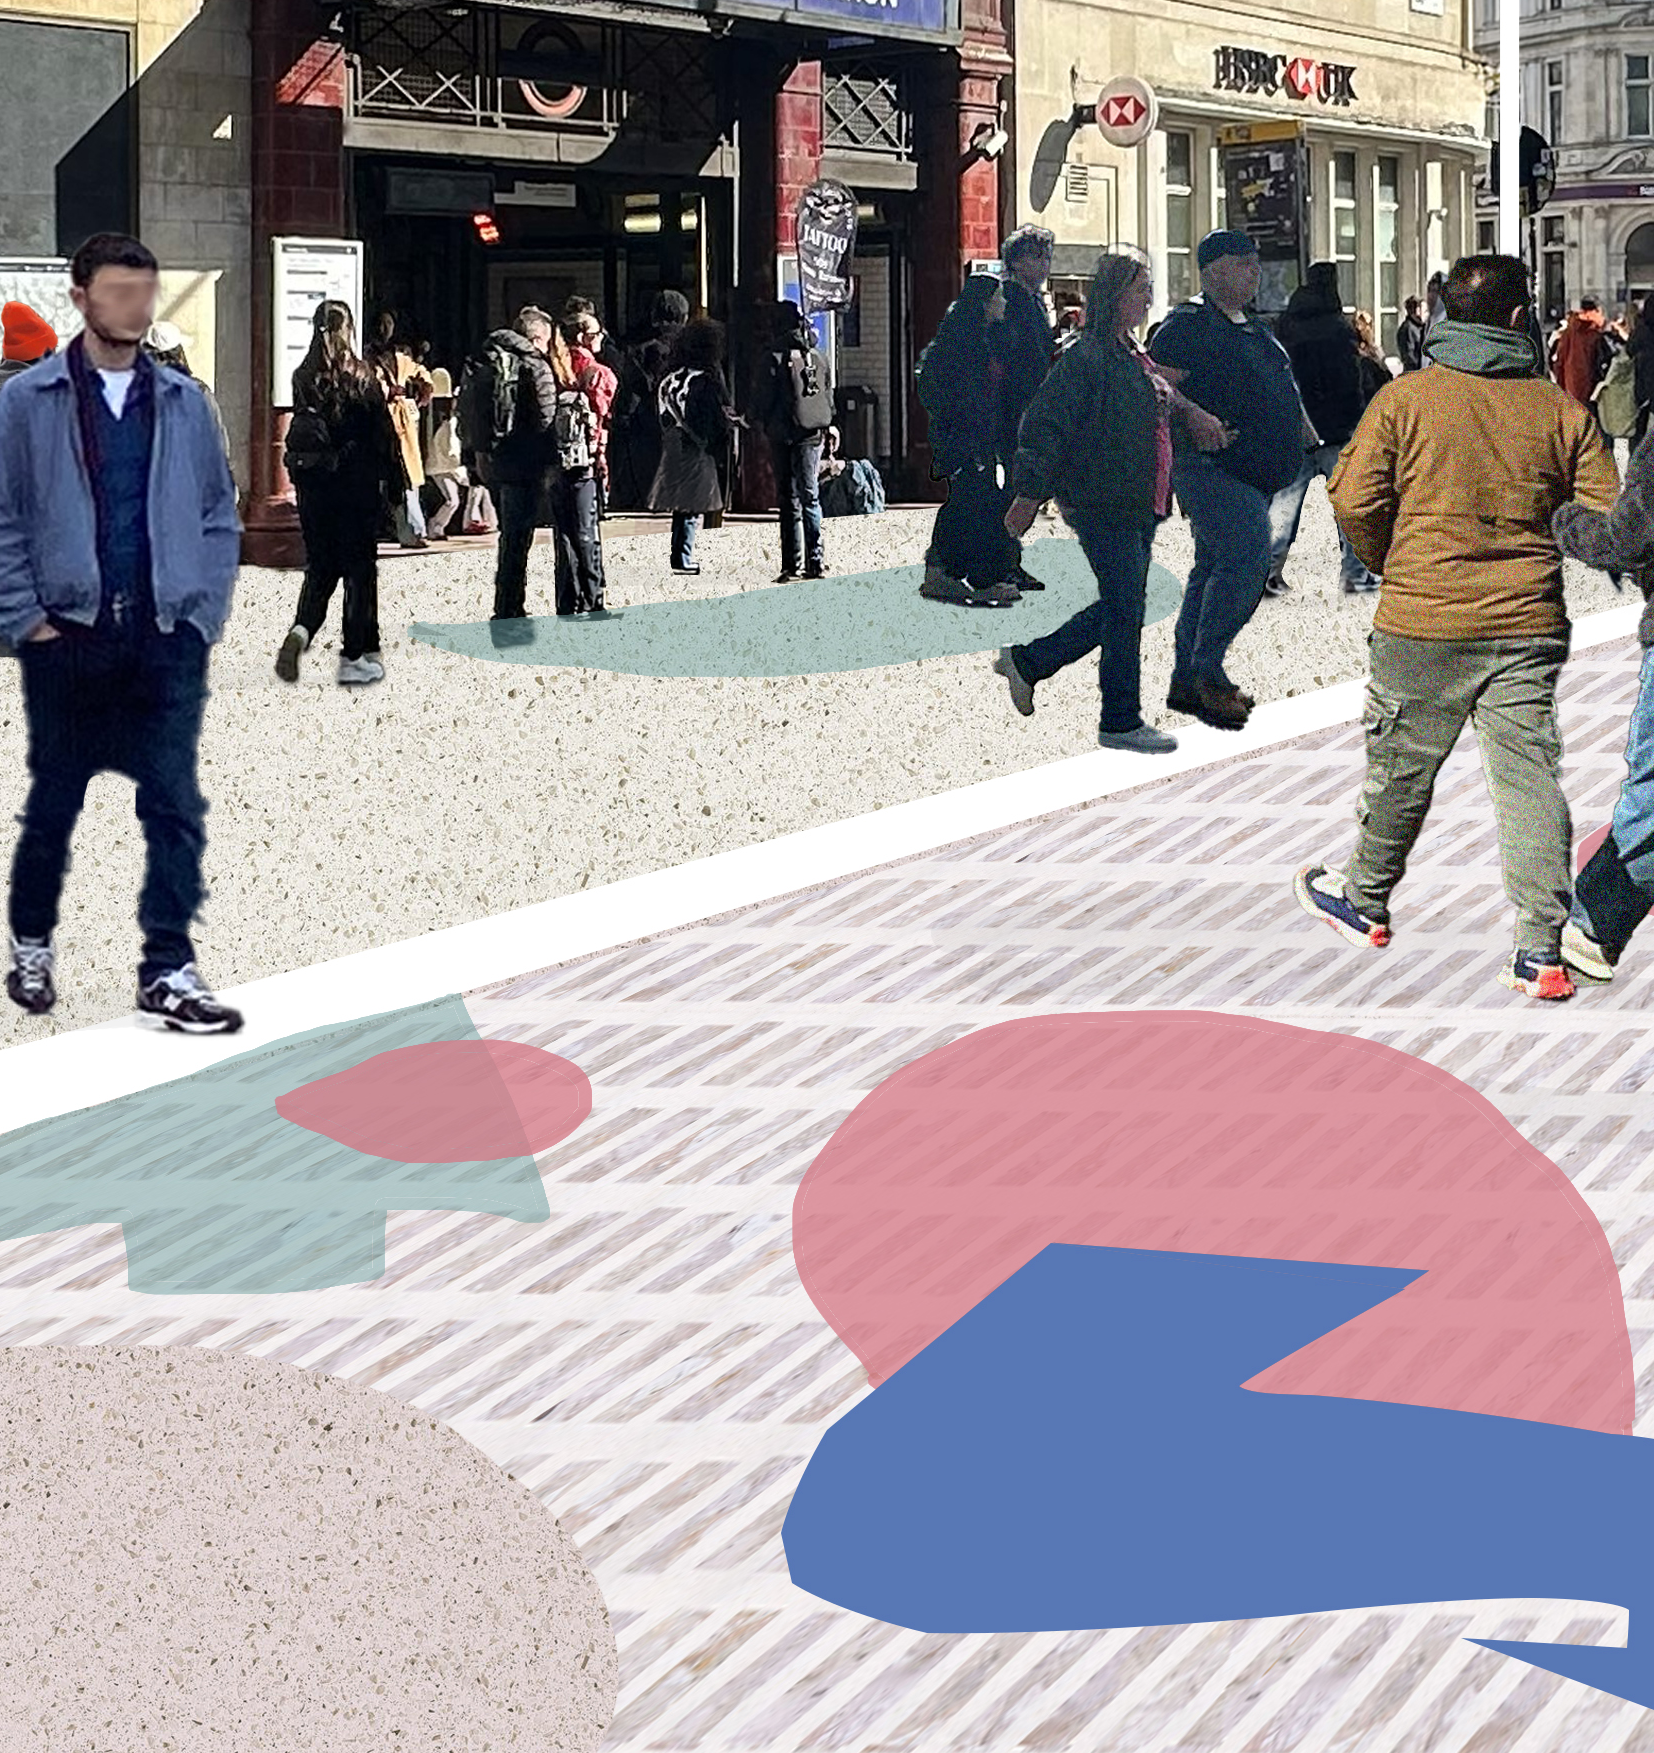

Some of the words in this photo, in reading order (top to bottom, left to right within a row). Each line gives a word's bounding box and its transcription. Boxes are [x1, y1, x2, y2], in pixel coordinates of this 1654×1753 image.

[1213, 46, 1287, 97] HSBC
[1317, 62, 1360, 106] UK
[803, 224, 848, 255] TATTOO
